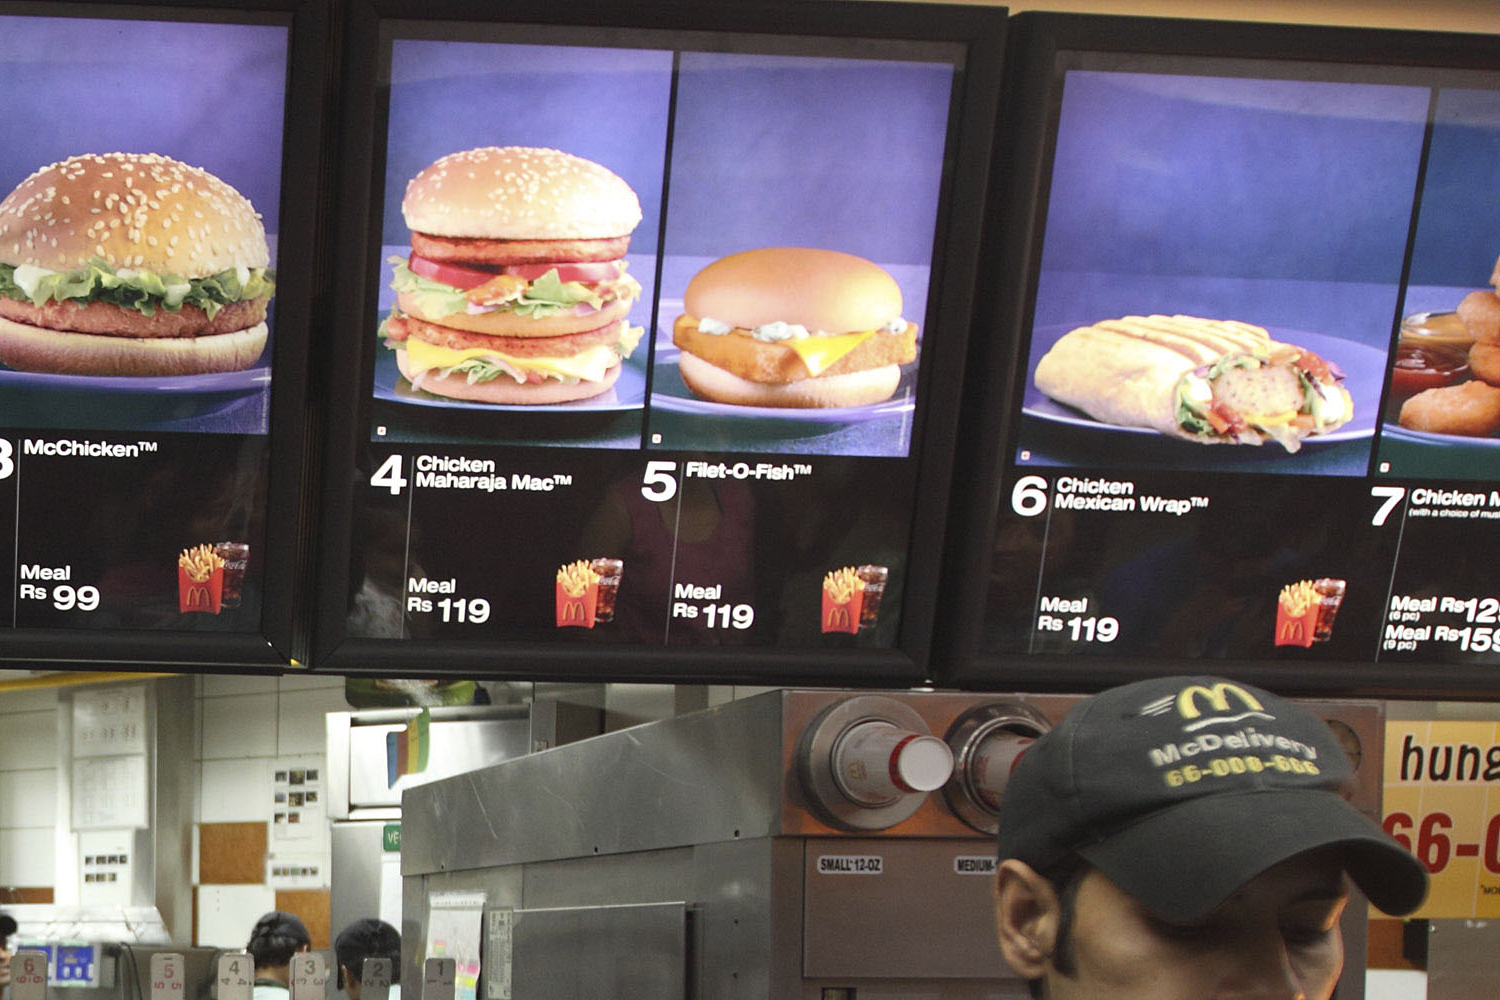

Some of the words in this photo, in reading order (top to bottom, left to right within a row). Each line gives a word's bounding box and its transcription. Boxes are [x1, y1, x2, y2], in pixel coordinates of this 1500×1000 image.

[371, 455, 407, 494] 4
[417, 455, 495, 474] Chicken
[415, 473, 508, 493] Maharaja
[642, 461, 676, 501] 5
[1011, 476, 1048, 516] 6
[1056, 477, 1134, 496] Chicken
[1054, 494, 1136, 513] Mexican
[1371, 486, 1405, 526] 7
[1411, 488, 1486, 506] Chicken
[21, 565, 70, 580] Meal
[20, 584, 47, 600] Rs
[52, 585, 100, 611] 99
[408, 578, 456, 594] Meal
[674, 583, 722, 600] Meal
[407, 597, 433, 613] Rs
[438, 598, 491, 624] 119
[1040, 596, 1088, 614] Meal
[1390, 595, 1437, 612] Meal
[673, 602, 698, 619] Rs
[703, 604, 754, 630] 119
[1038, 615, 1063, 632] Rs
[1068, 616, 1120, 643] 119
[1385, 624, 1431, 641] Meal
[1150, 727, 1318, 767] McDelivery
[854, 858, 881, 872] 12-OZ
